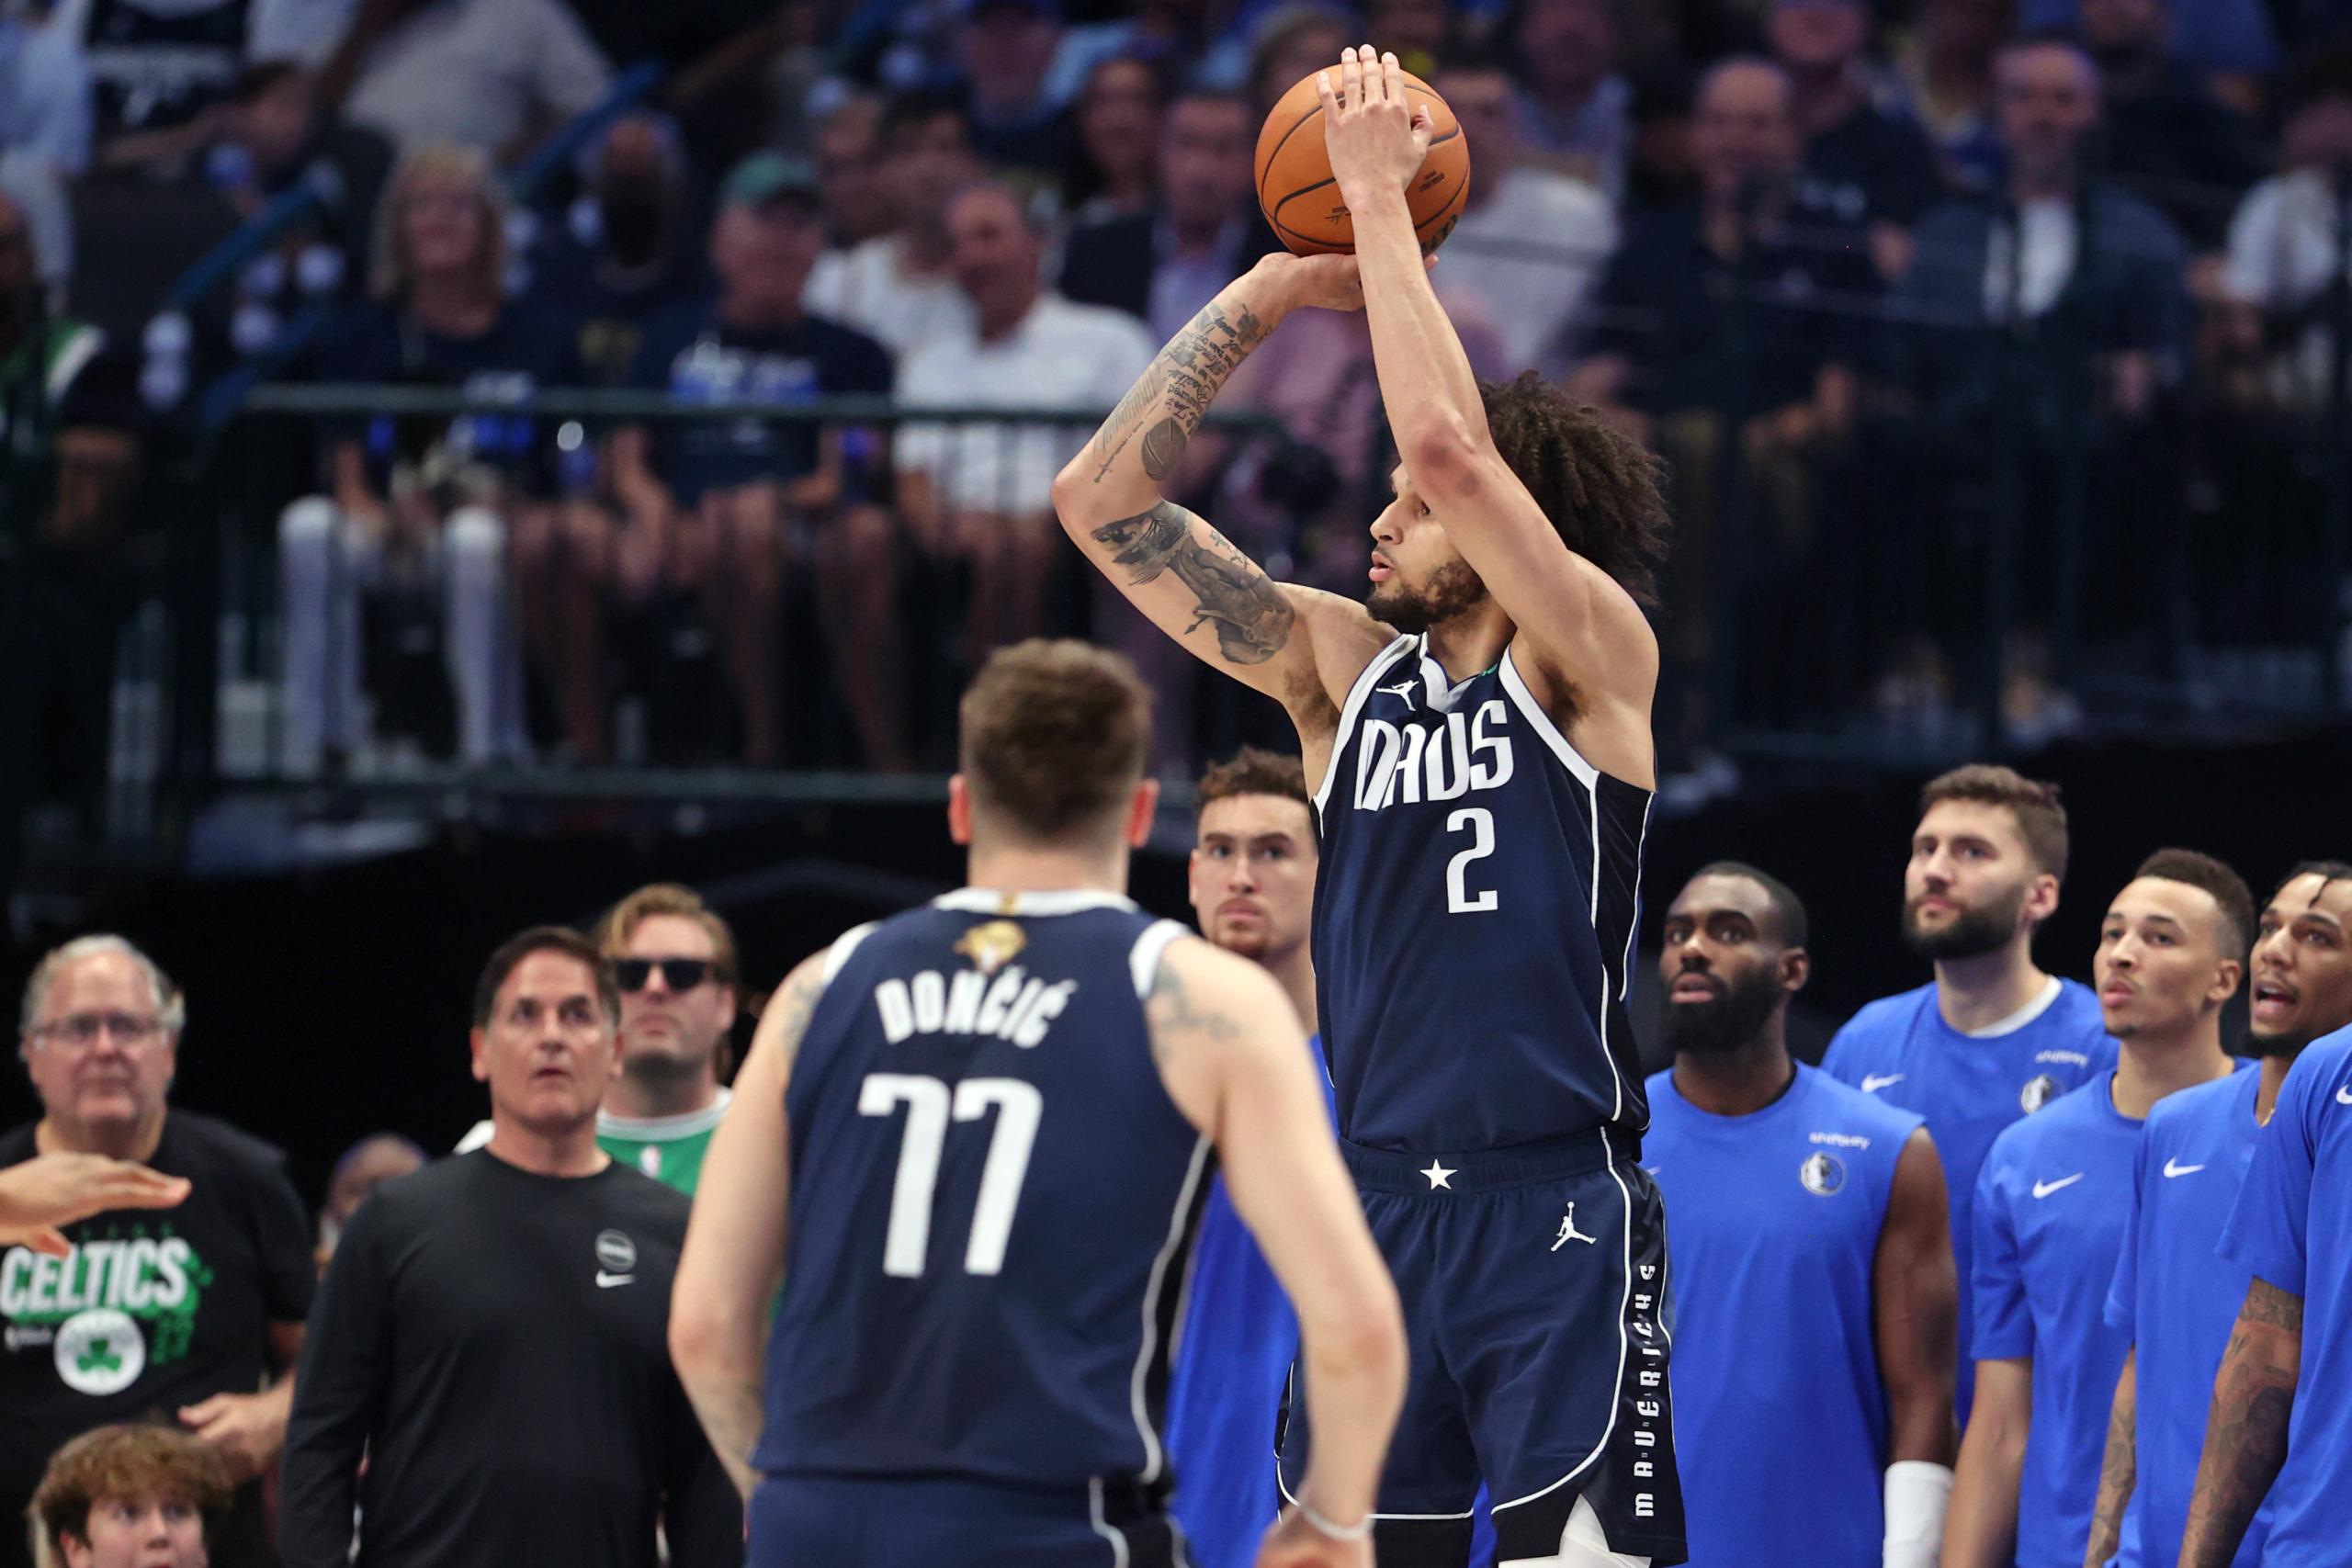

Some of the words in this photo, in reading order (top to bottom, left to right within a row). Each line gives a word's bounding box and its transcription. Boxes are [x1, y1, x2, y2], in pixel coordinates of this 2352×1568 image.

[1446, 807, 1498, 914] 2
[875, 965, 1079, 1049] DONČIĆ
[858, 1073, 1044, 1278] 77
[0, 1236, 190, 1317] CELTICS
[1634, 1264, 1661, 1517] MAVERICKS
